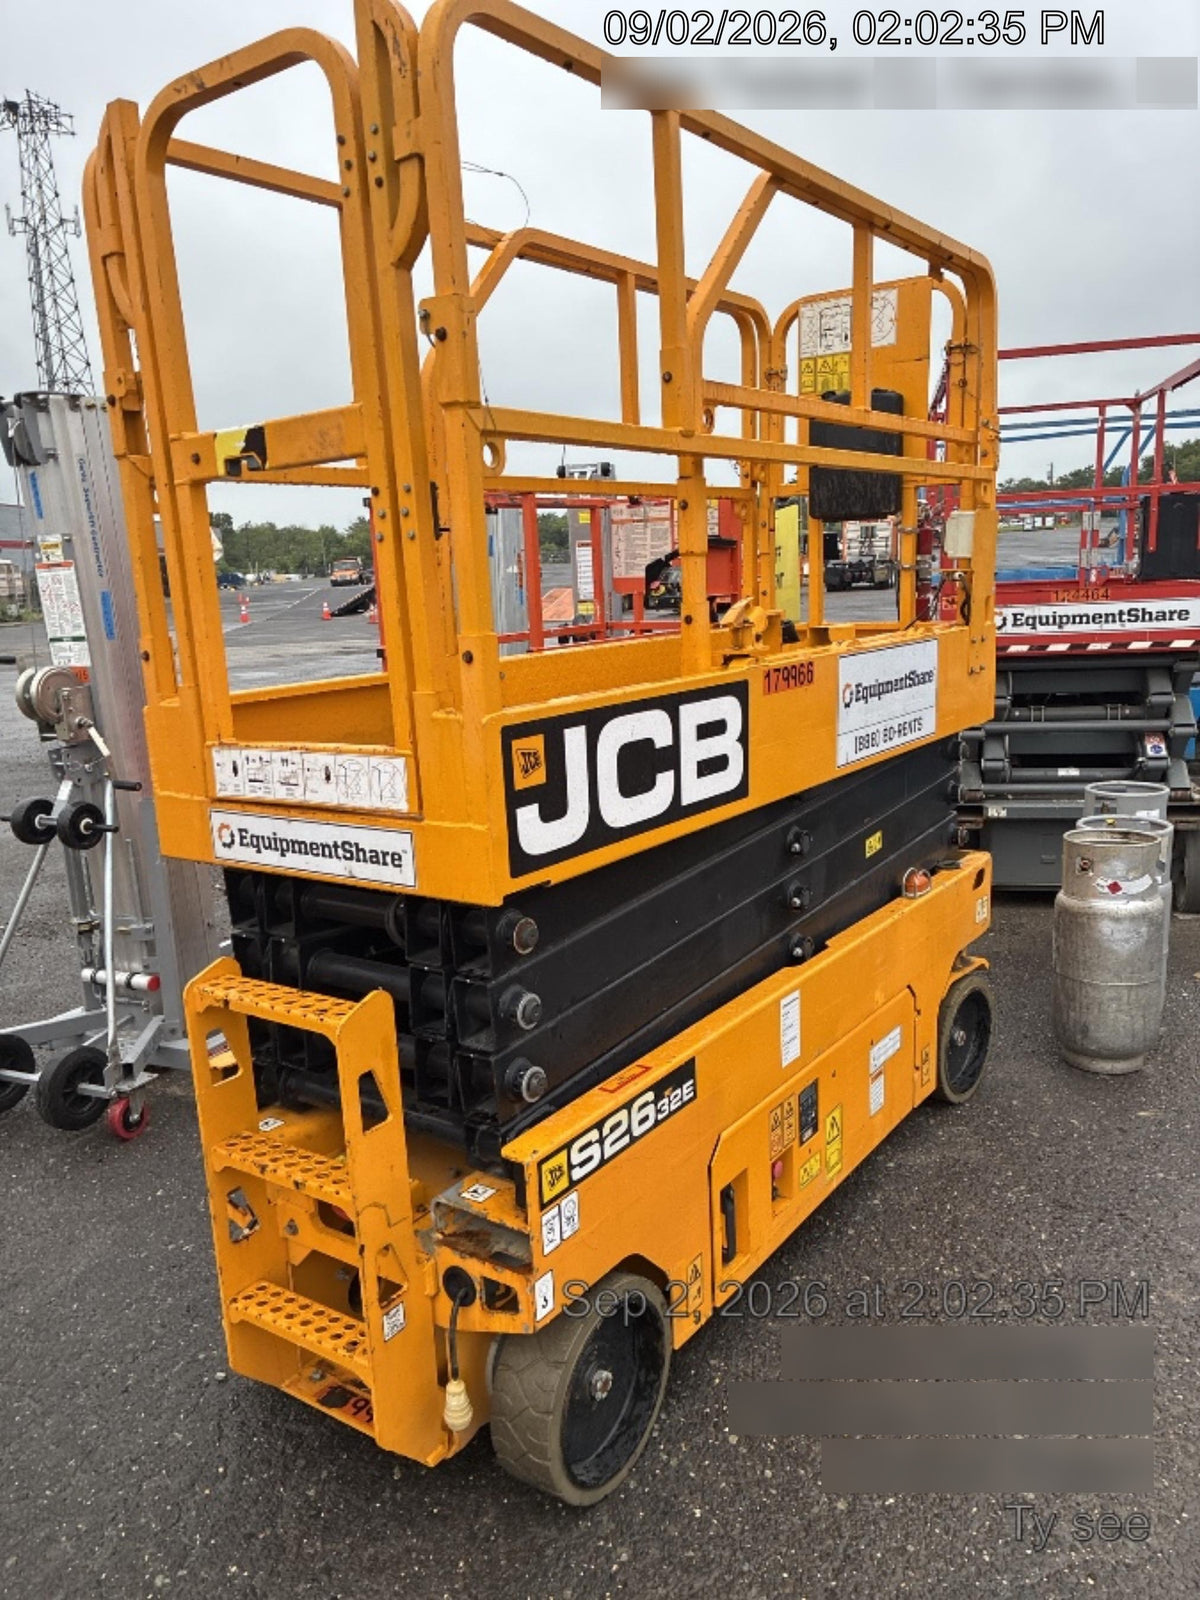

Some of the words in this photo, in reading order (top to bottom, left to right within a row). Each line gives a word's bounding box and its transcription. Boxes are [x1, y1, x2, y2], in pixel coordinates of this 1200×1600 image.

[1011, 607, 1190, 631] EquipmentShare
[764, 660, 815, 694] 179966
[854, 668, 935, 705] EquipmentShare
[516, 695, 744, 856] JCB
[237, 827, 403, 869] EquipmentShare
